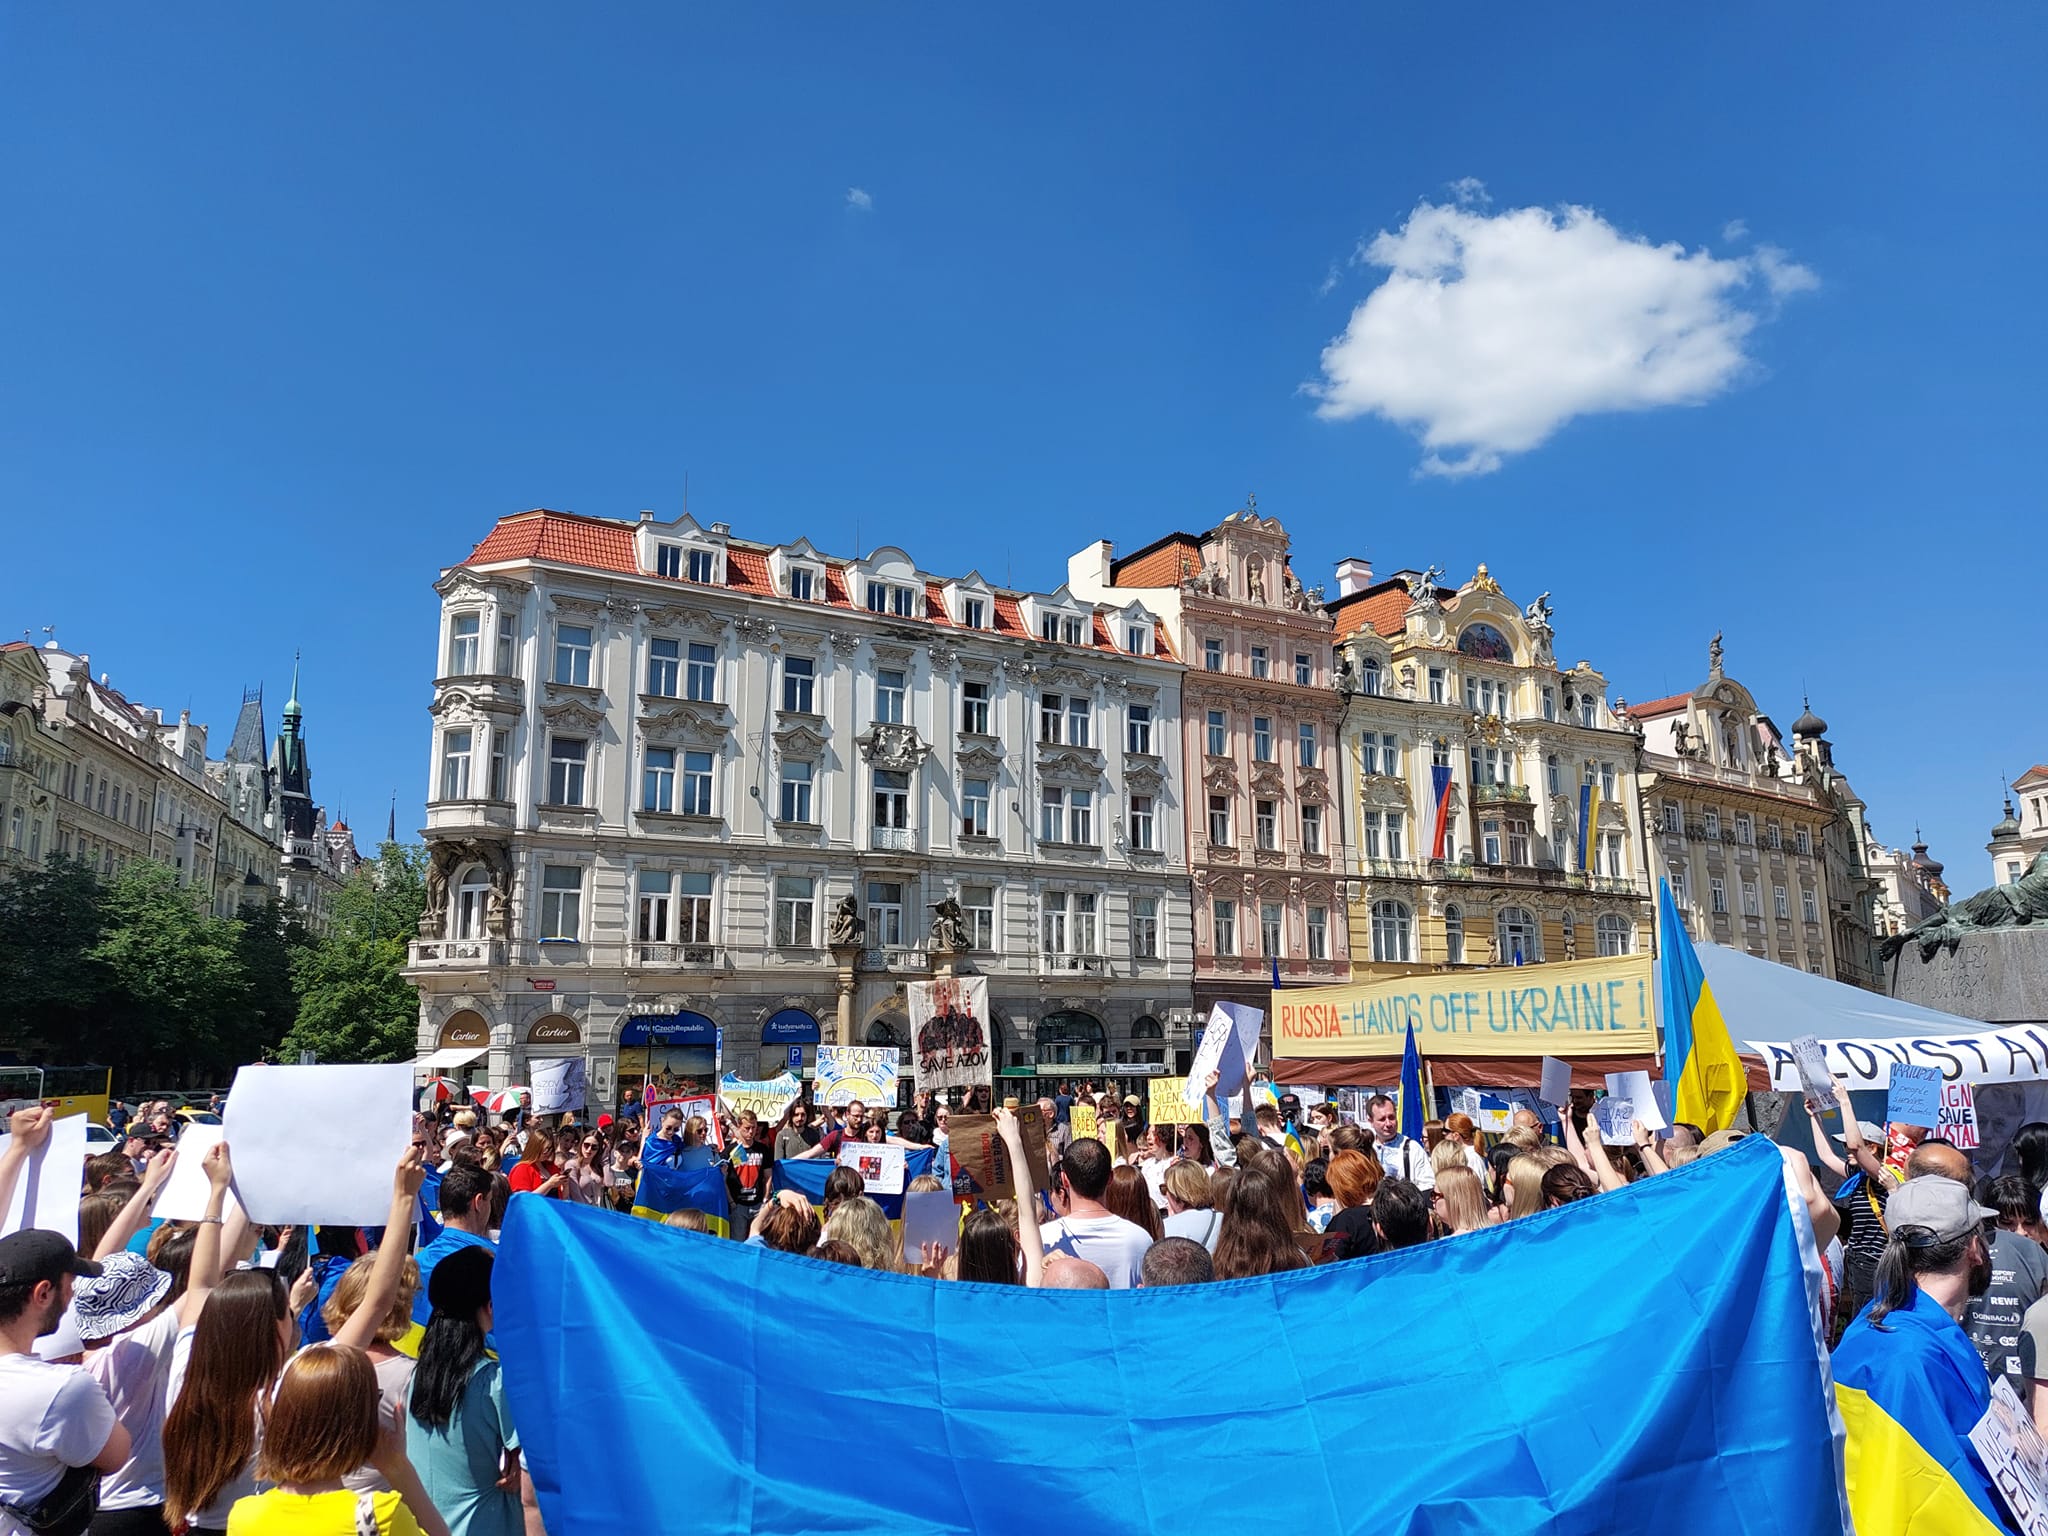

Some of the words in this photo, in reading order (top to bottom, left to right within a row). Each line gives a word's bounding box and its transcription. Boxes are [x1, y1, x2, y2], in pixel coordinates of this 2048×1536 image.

[1430, 991, 1480, 1034] OFF
[1487, 979, 1626, 1033] UKRAINE
[451, 1030, 480, 1040] Cartier
[536, 1026, 573, 1037] Cartier
[636, 1025, 704, 1033] #VistCzechRepublic
[817, 1047, 846, 1062] SAVE
[851, 1061, 879, 1074] NOW
[920, 1056, 953, 1074] SAVE
[956, 1051, 989, 1069] AZOV
[1938, 1106, 1973, 1124] SAVE
[1990, 1296, 2019, 1306] REWE
